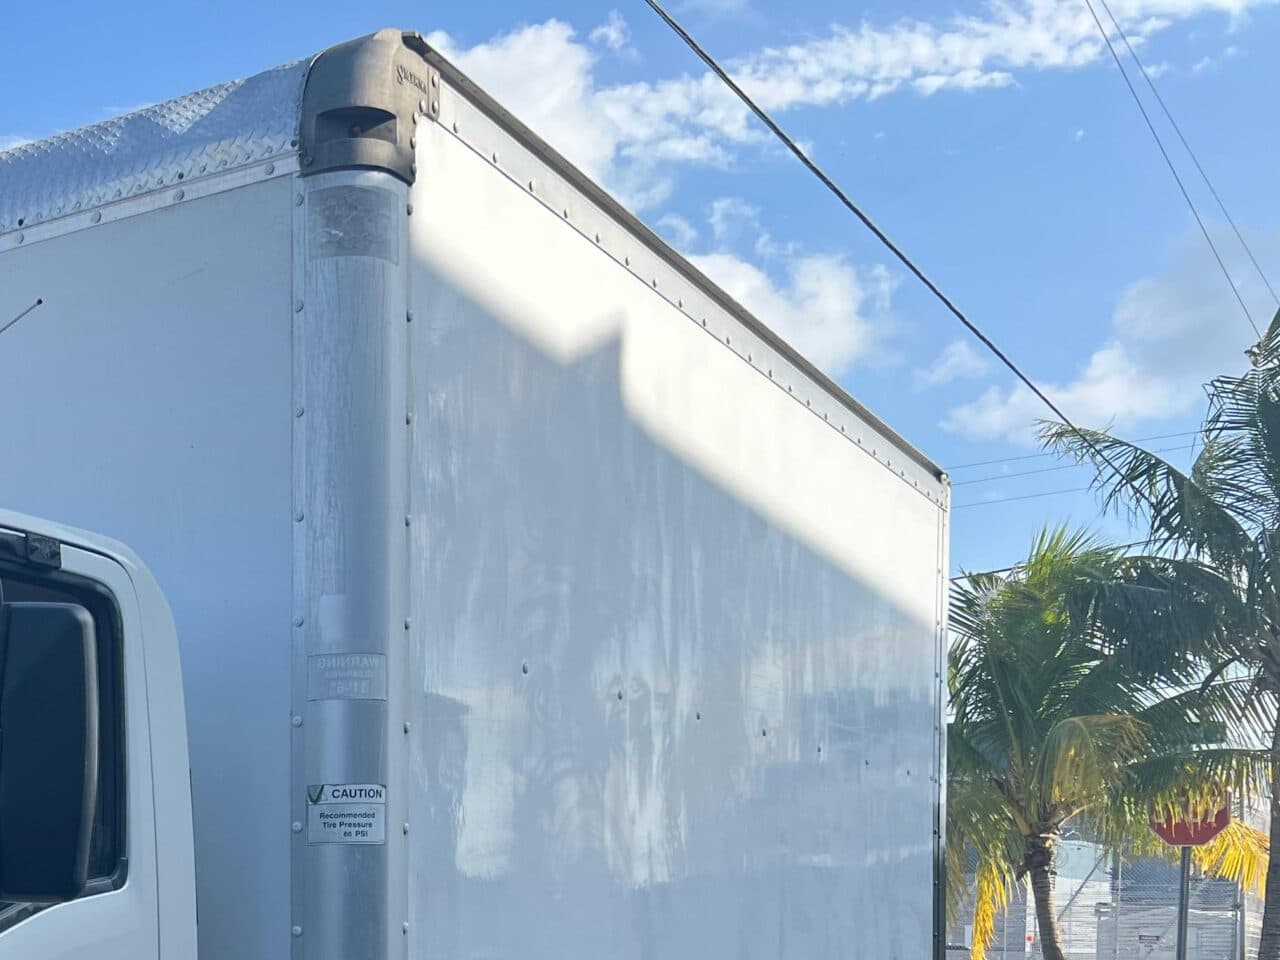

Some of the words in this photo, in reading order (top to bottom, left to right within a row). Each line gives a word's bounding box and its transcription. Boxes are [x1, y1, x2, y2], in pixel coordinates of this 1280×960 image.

[331, 788, 382, 799] CAUTION
[319, 812, 376, 820] Recommended
[322, 821, 337, 829] Tire
[339, 821, 373, 829] Pressure
[355, 830, 368, 838] PSI
